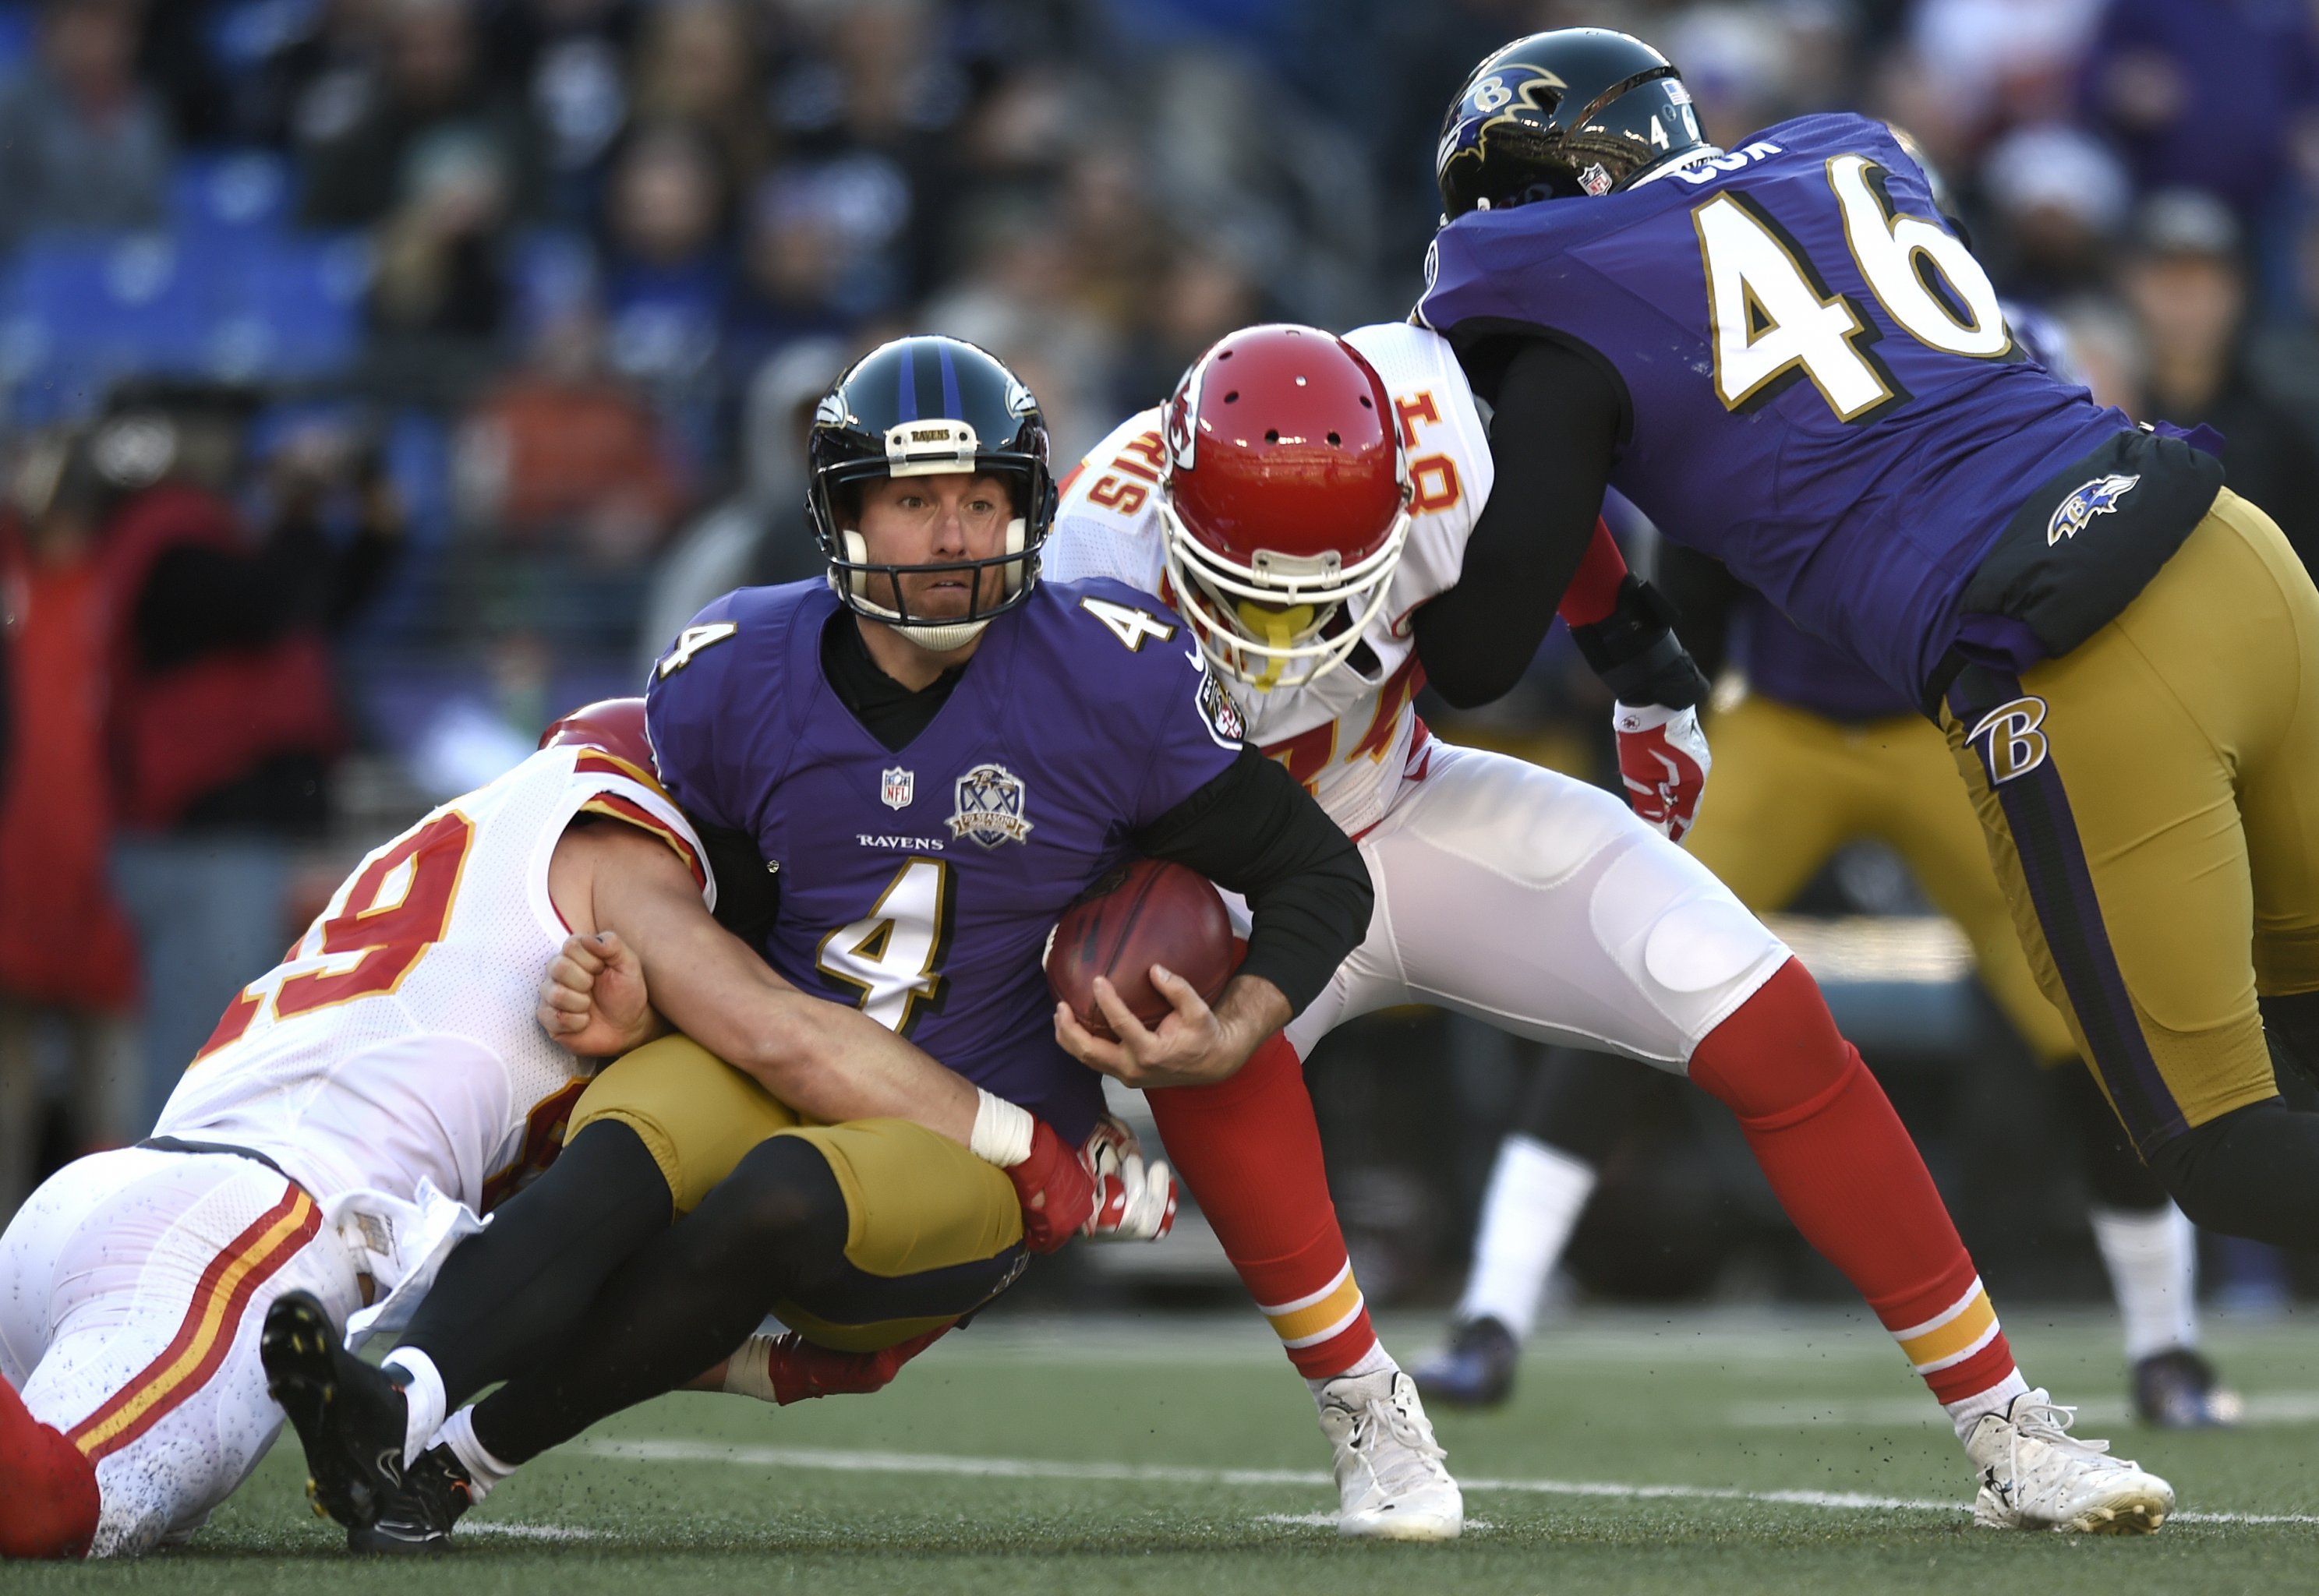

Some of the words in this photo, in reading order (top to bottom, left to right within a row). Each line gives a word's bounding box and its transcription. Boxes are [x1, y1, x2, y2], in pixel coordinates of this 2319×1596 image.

[1691, 154, 2013, 424] 46
[910, 429, 950, 443] RAVENS
[659, 620, 738, 680] 4
[1080, 596, 1175, 653] 4
[1964, 696, 2048, 786] B
[886, 786, 907, 803] NFL
[856, 834, 945, 851] RAVENS
[815, 856, 946, 1034] 4
